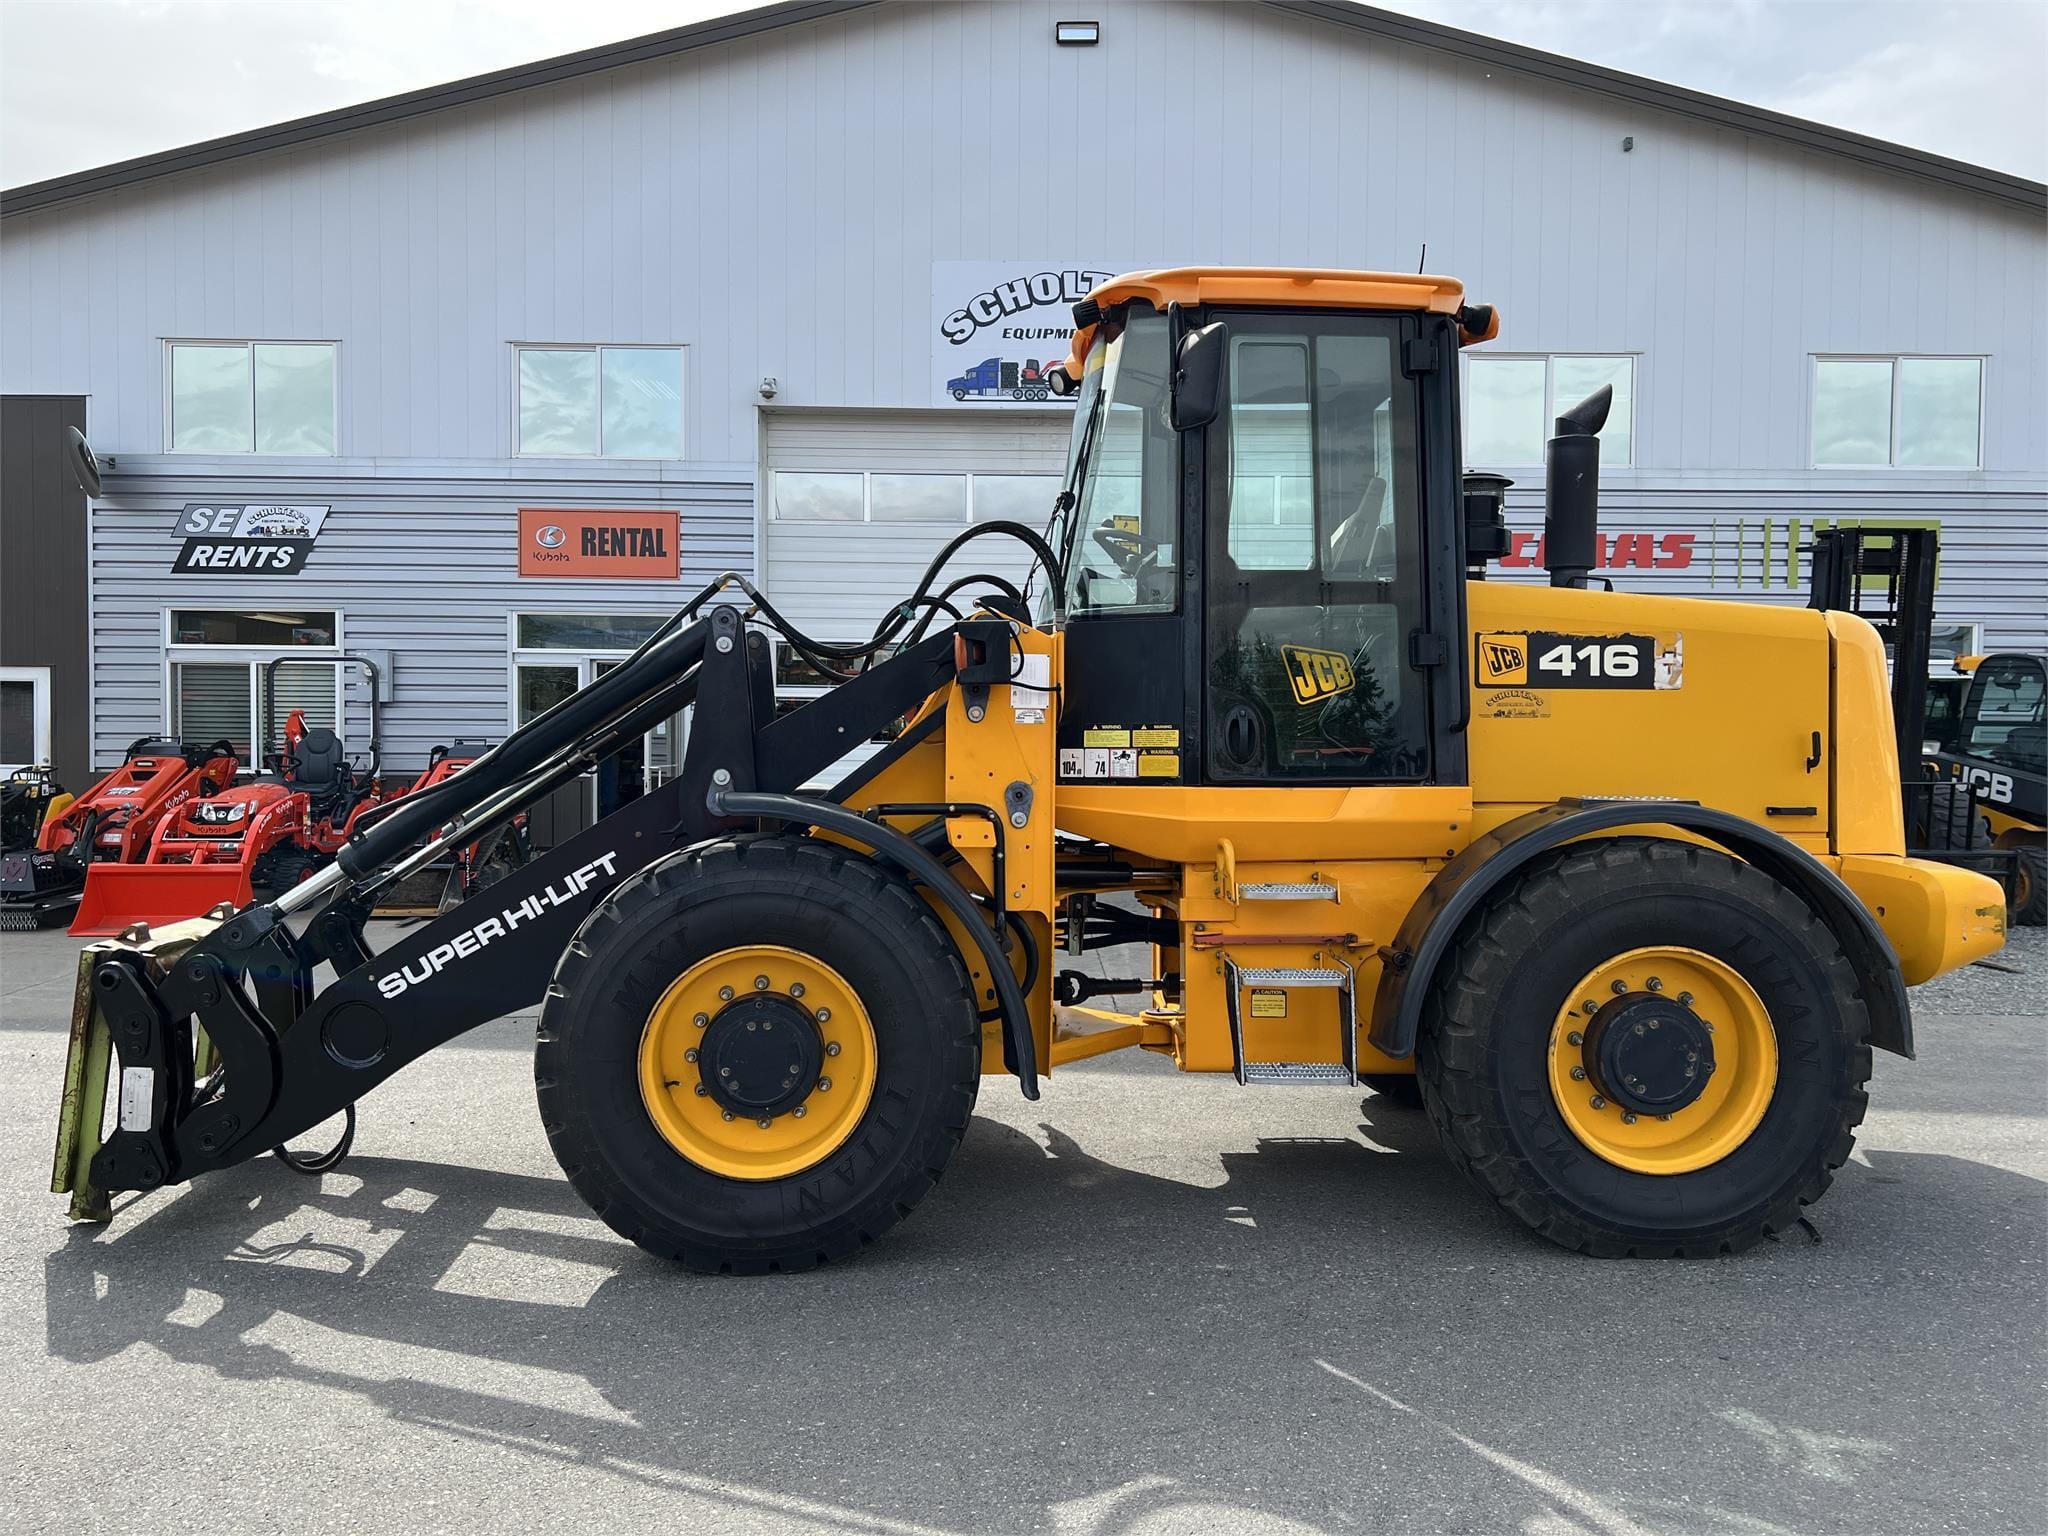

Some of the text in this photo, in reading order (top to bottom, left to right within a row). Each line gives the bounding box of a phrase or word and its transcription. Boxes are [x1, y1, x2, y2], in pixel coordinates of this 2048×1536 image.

[941, 270, 1117, 345] SCHOLT
[184, 507, 240, 533] SE
[581, 527, 667, 557] RENTAL
[1500, 533, 1696, 568] CAS
[187, 545, 295, 568] RENTS
[533, 551, 571, 562] Kubota
[1490, 646, 1523, 673] JCB
[1539, 644, 1640, 677] 416
[1293, 650, 1352, 698] JCB
[1062, 761, 1076, 775] 104
[1095, 761, 1106, 775] 74
[1951, 766, 2014, 804] JCB
[165, 789, 190, 810] Kubota
[197, 826, 227, 834] Kubota
[377, 917, 506, 999] SUPER
[502, 850, 617, 931] HI-LIFT
